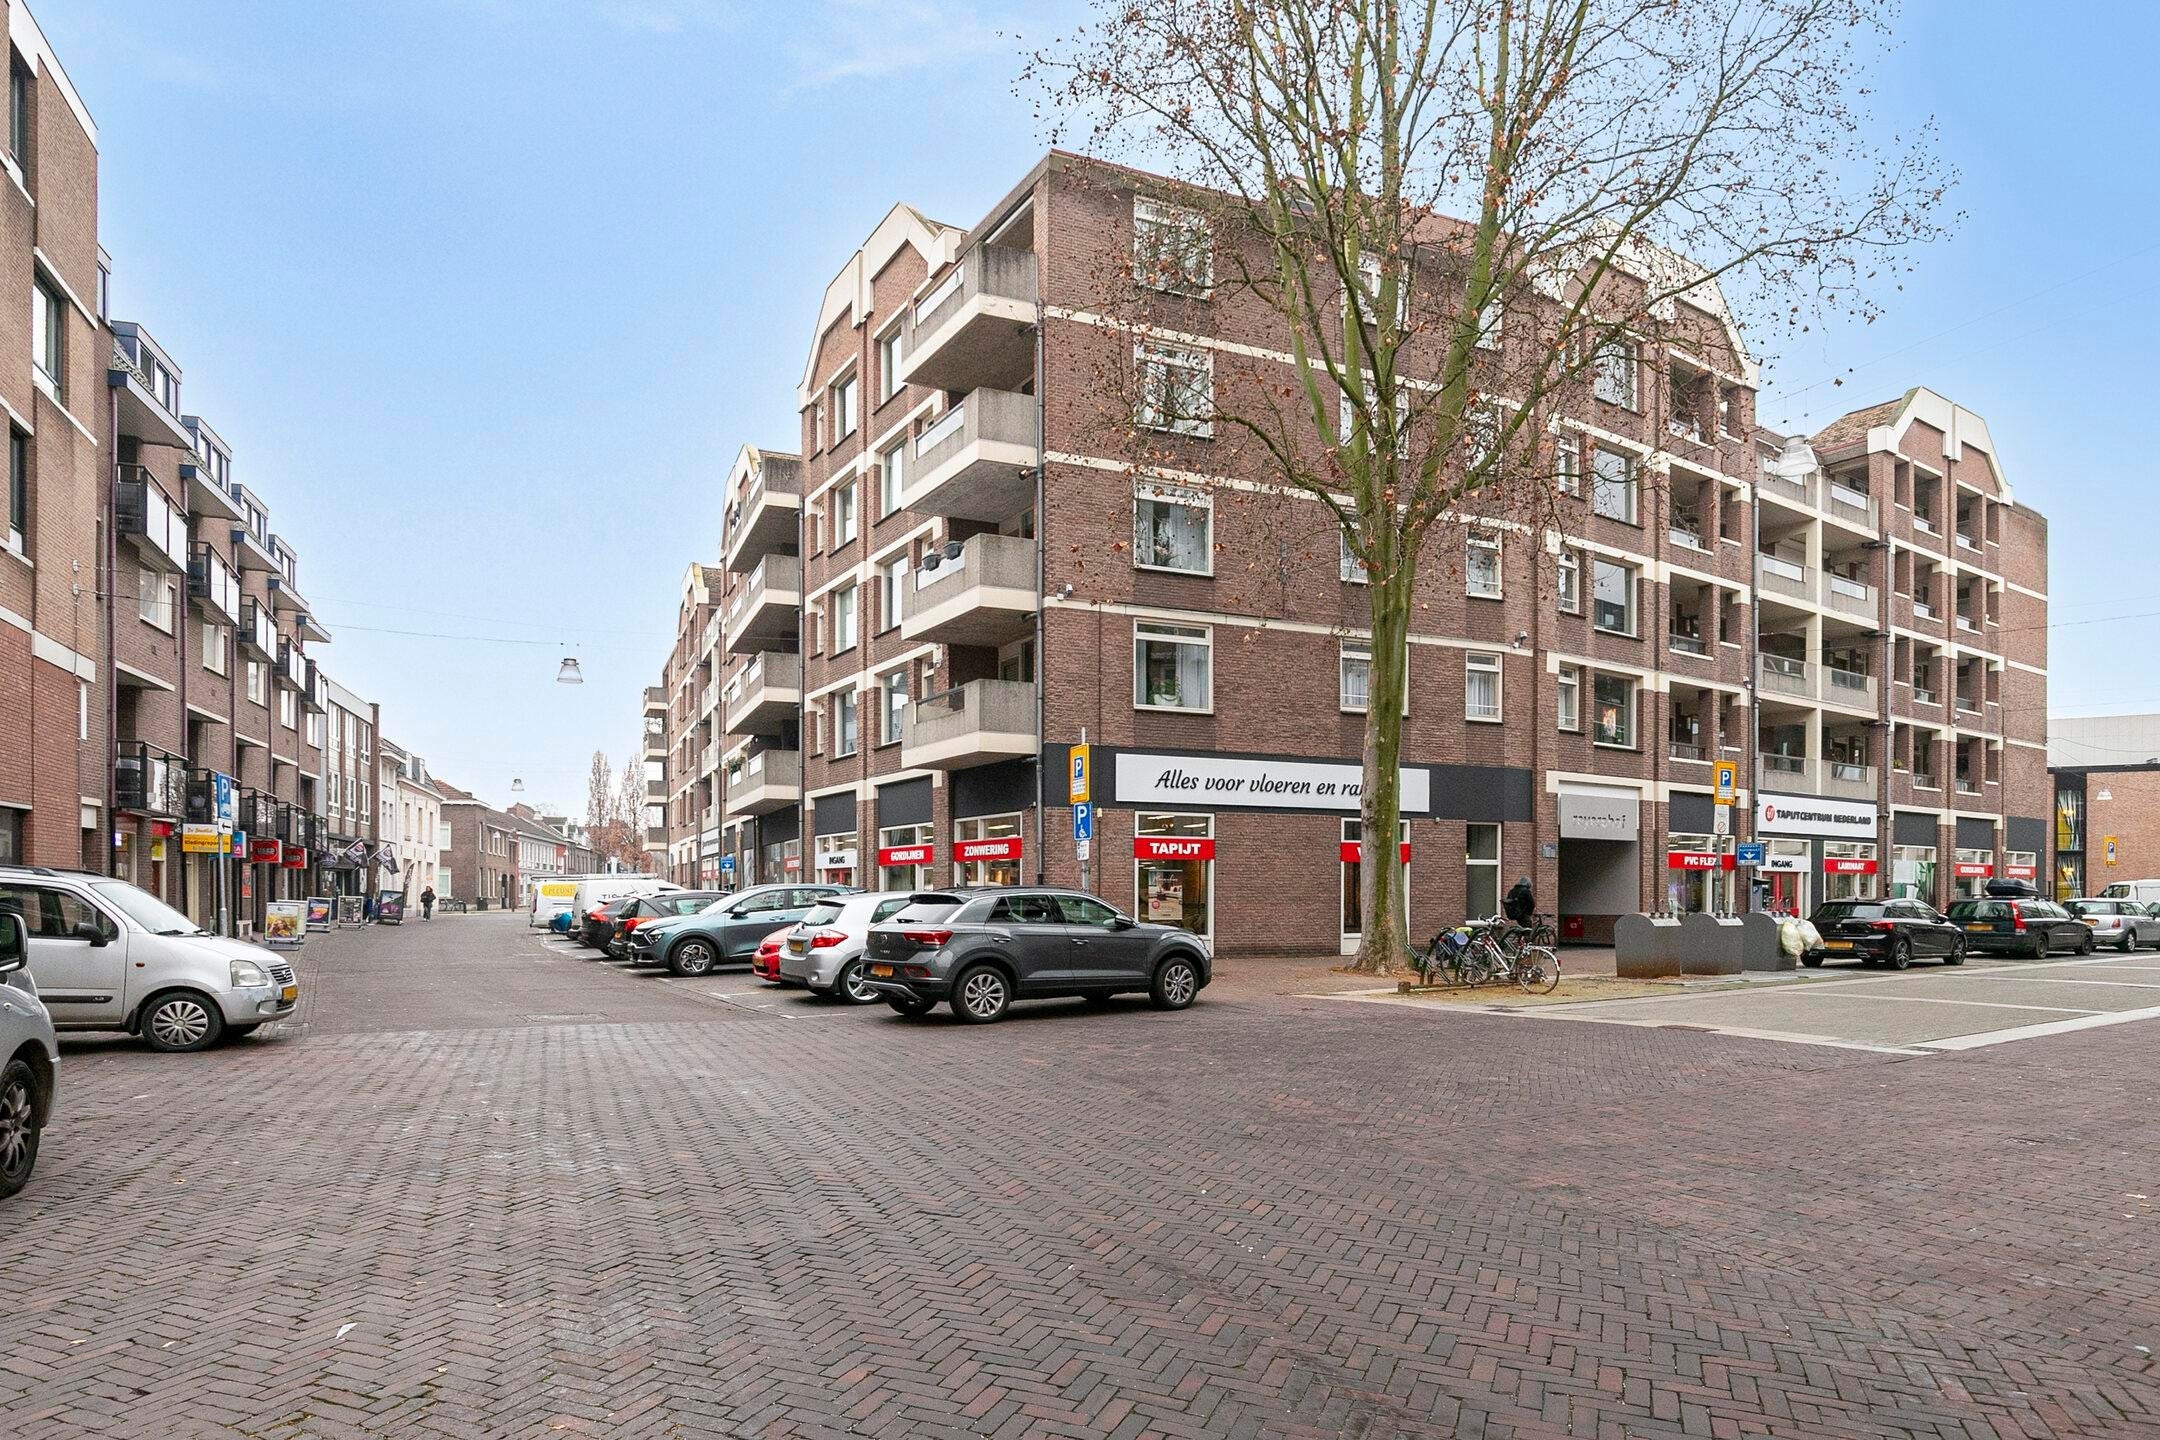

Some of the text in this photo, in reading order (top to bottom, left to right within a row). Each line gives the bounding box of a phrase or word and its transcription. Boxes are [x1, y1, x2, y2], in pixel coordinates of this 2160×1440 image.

[1075, 759, 1082, 777] P
[1155, 769, 1363, 797] Alles voor vloeren en ra
[1722, 771, 1730, 785] P
[1077, 805, 1087, 824] P
[1776, 810, 1832, 823] TAPIJTCENTRUM
[1833, 815, 1872, 825] NEDERLAND
[890, 849, 924, 861] GORDIJNEN
[964, 843, 1010, 857] ZONWERING
[1150, 842, 1201, 855] TAPIJT
[828, 855, 846, 865] INGANG
[1684, 856, 1699, 866] PVC
[1771, 860, 1793, 869] INGANG
[1837, 862, 1865, 871] LAMINAAT
